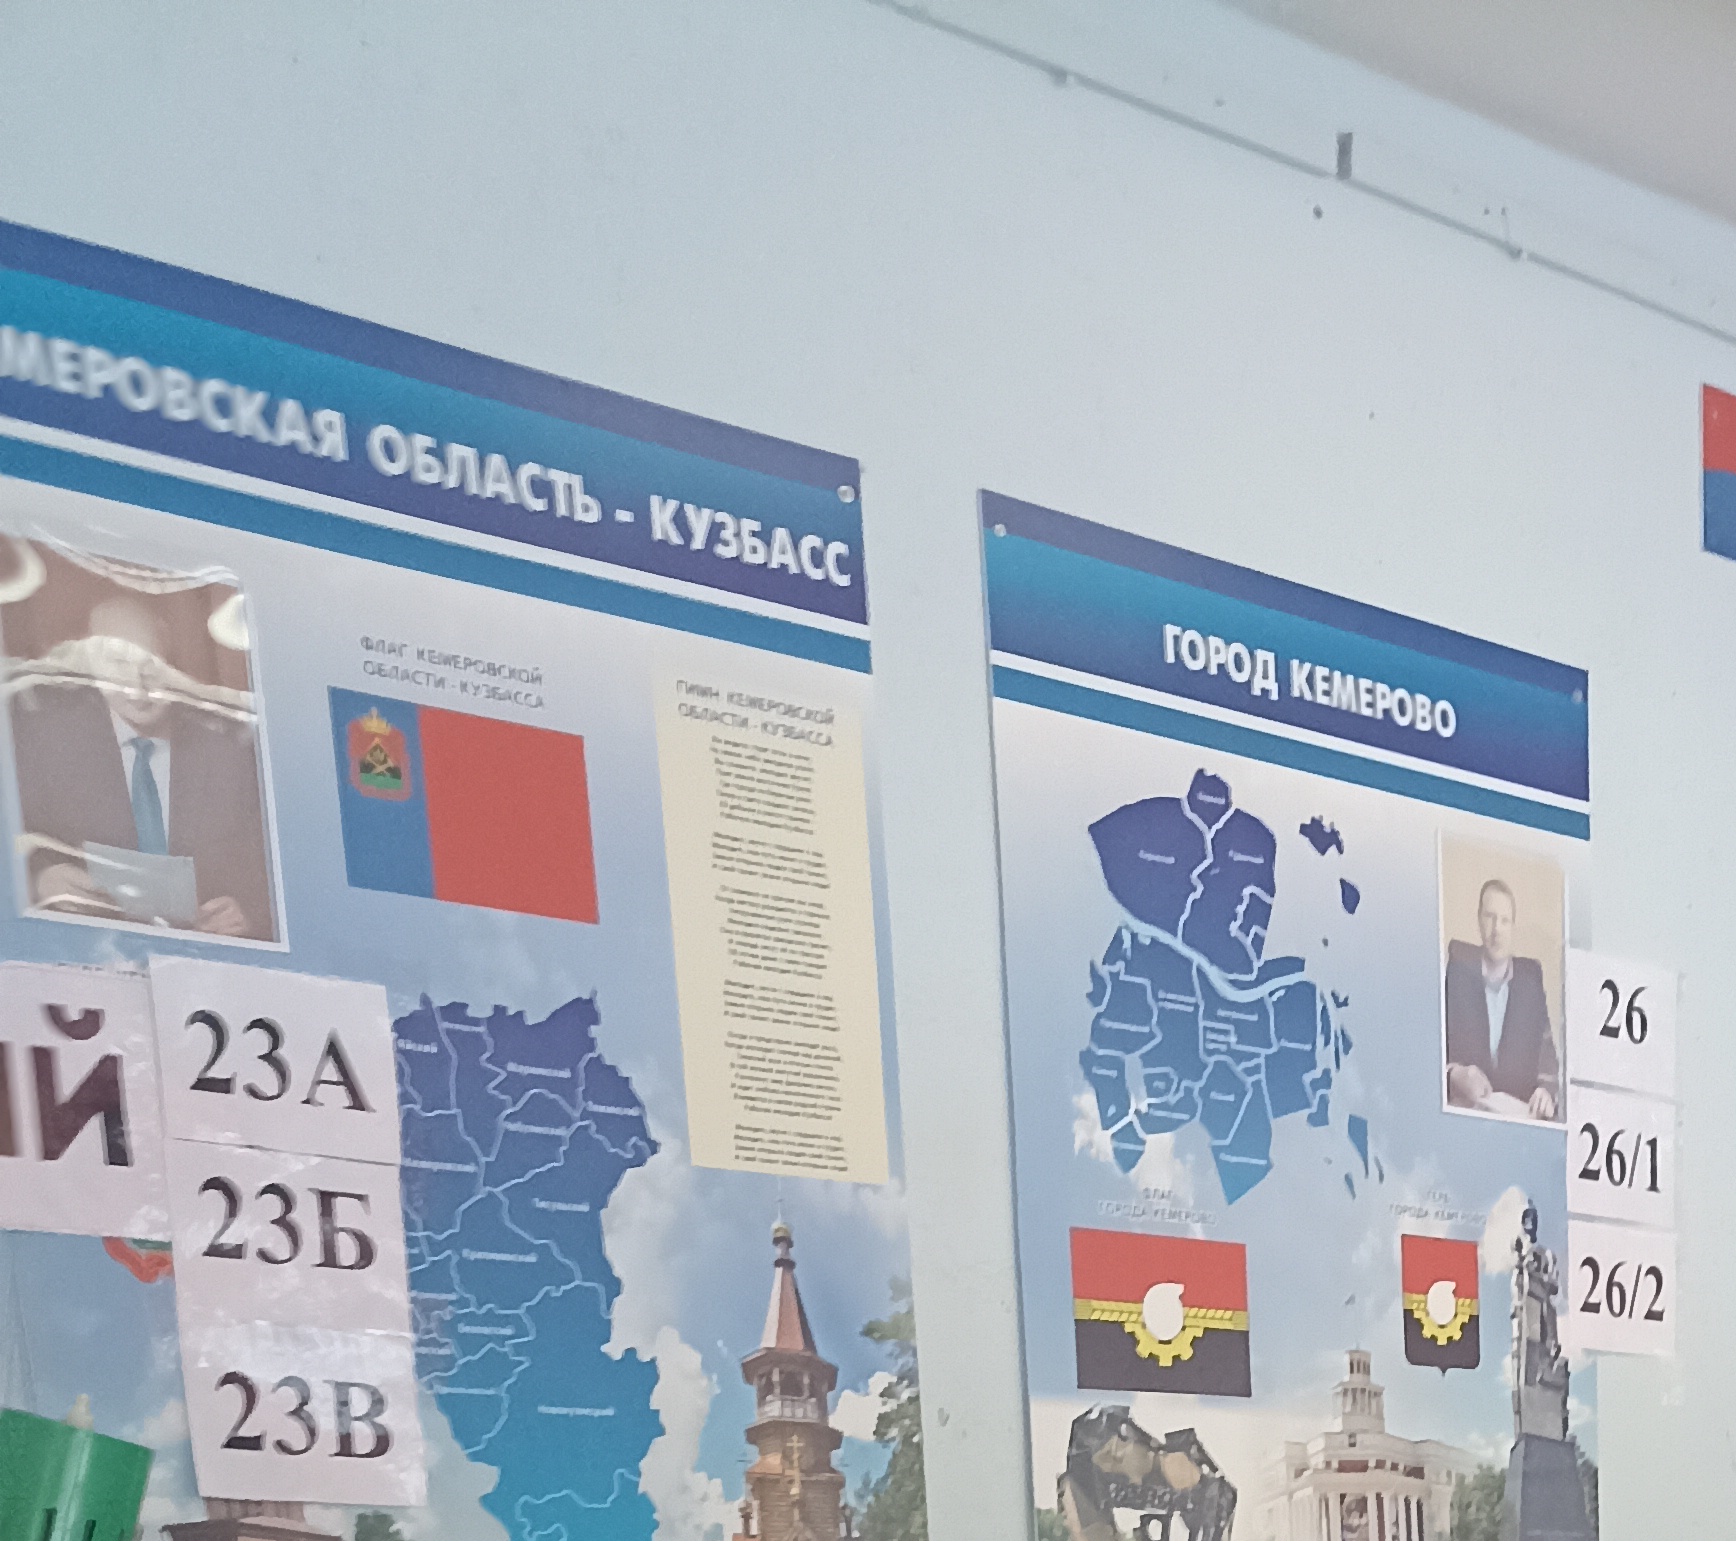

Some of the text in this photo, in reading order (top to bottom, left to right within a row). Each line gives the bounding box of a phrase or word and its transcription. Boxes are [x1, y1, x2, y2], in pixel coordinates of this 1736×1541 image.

[366, 424, 602, 524] ОБЛАСТЬ
[650, 494, 852, 588] КУЗБАСС
[1163, 623, 1457, 738] ГОРОД КЕМЕРОВО
[1599, 978, 1649, 1045] 26
[185, 1008, 377, 1113] 23А
[1578, 1122, 1661, 1193] 26/1
[198, 1175, 379, 1271] 23Б
[1579, 1256, 1665, 1322] 26/2
[213, 1370, 395, 1459] 23В
